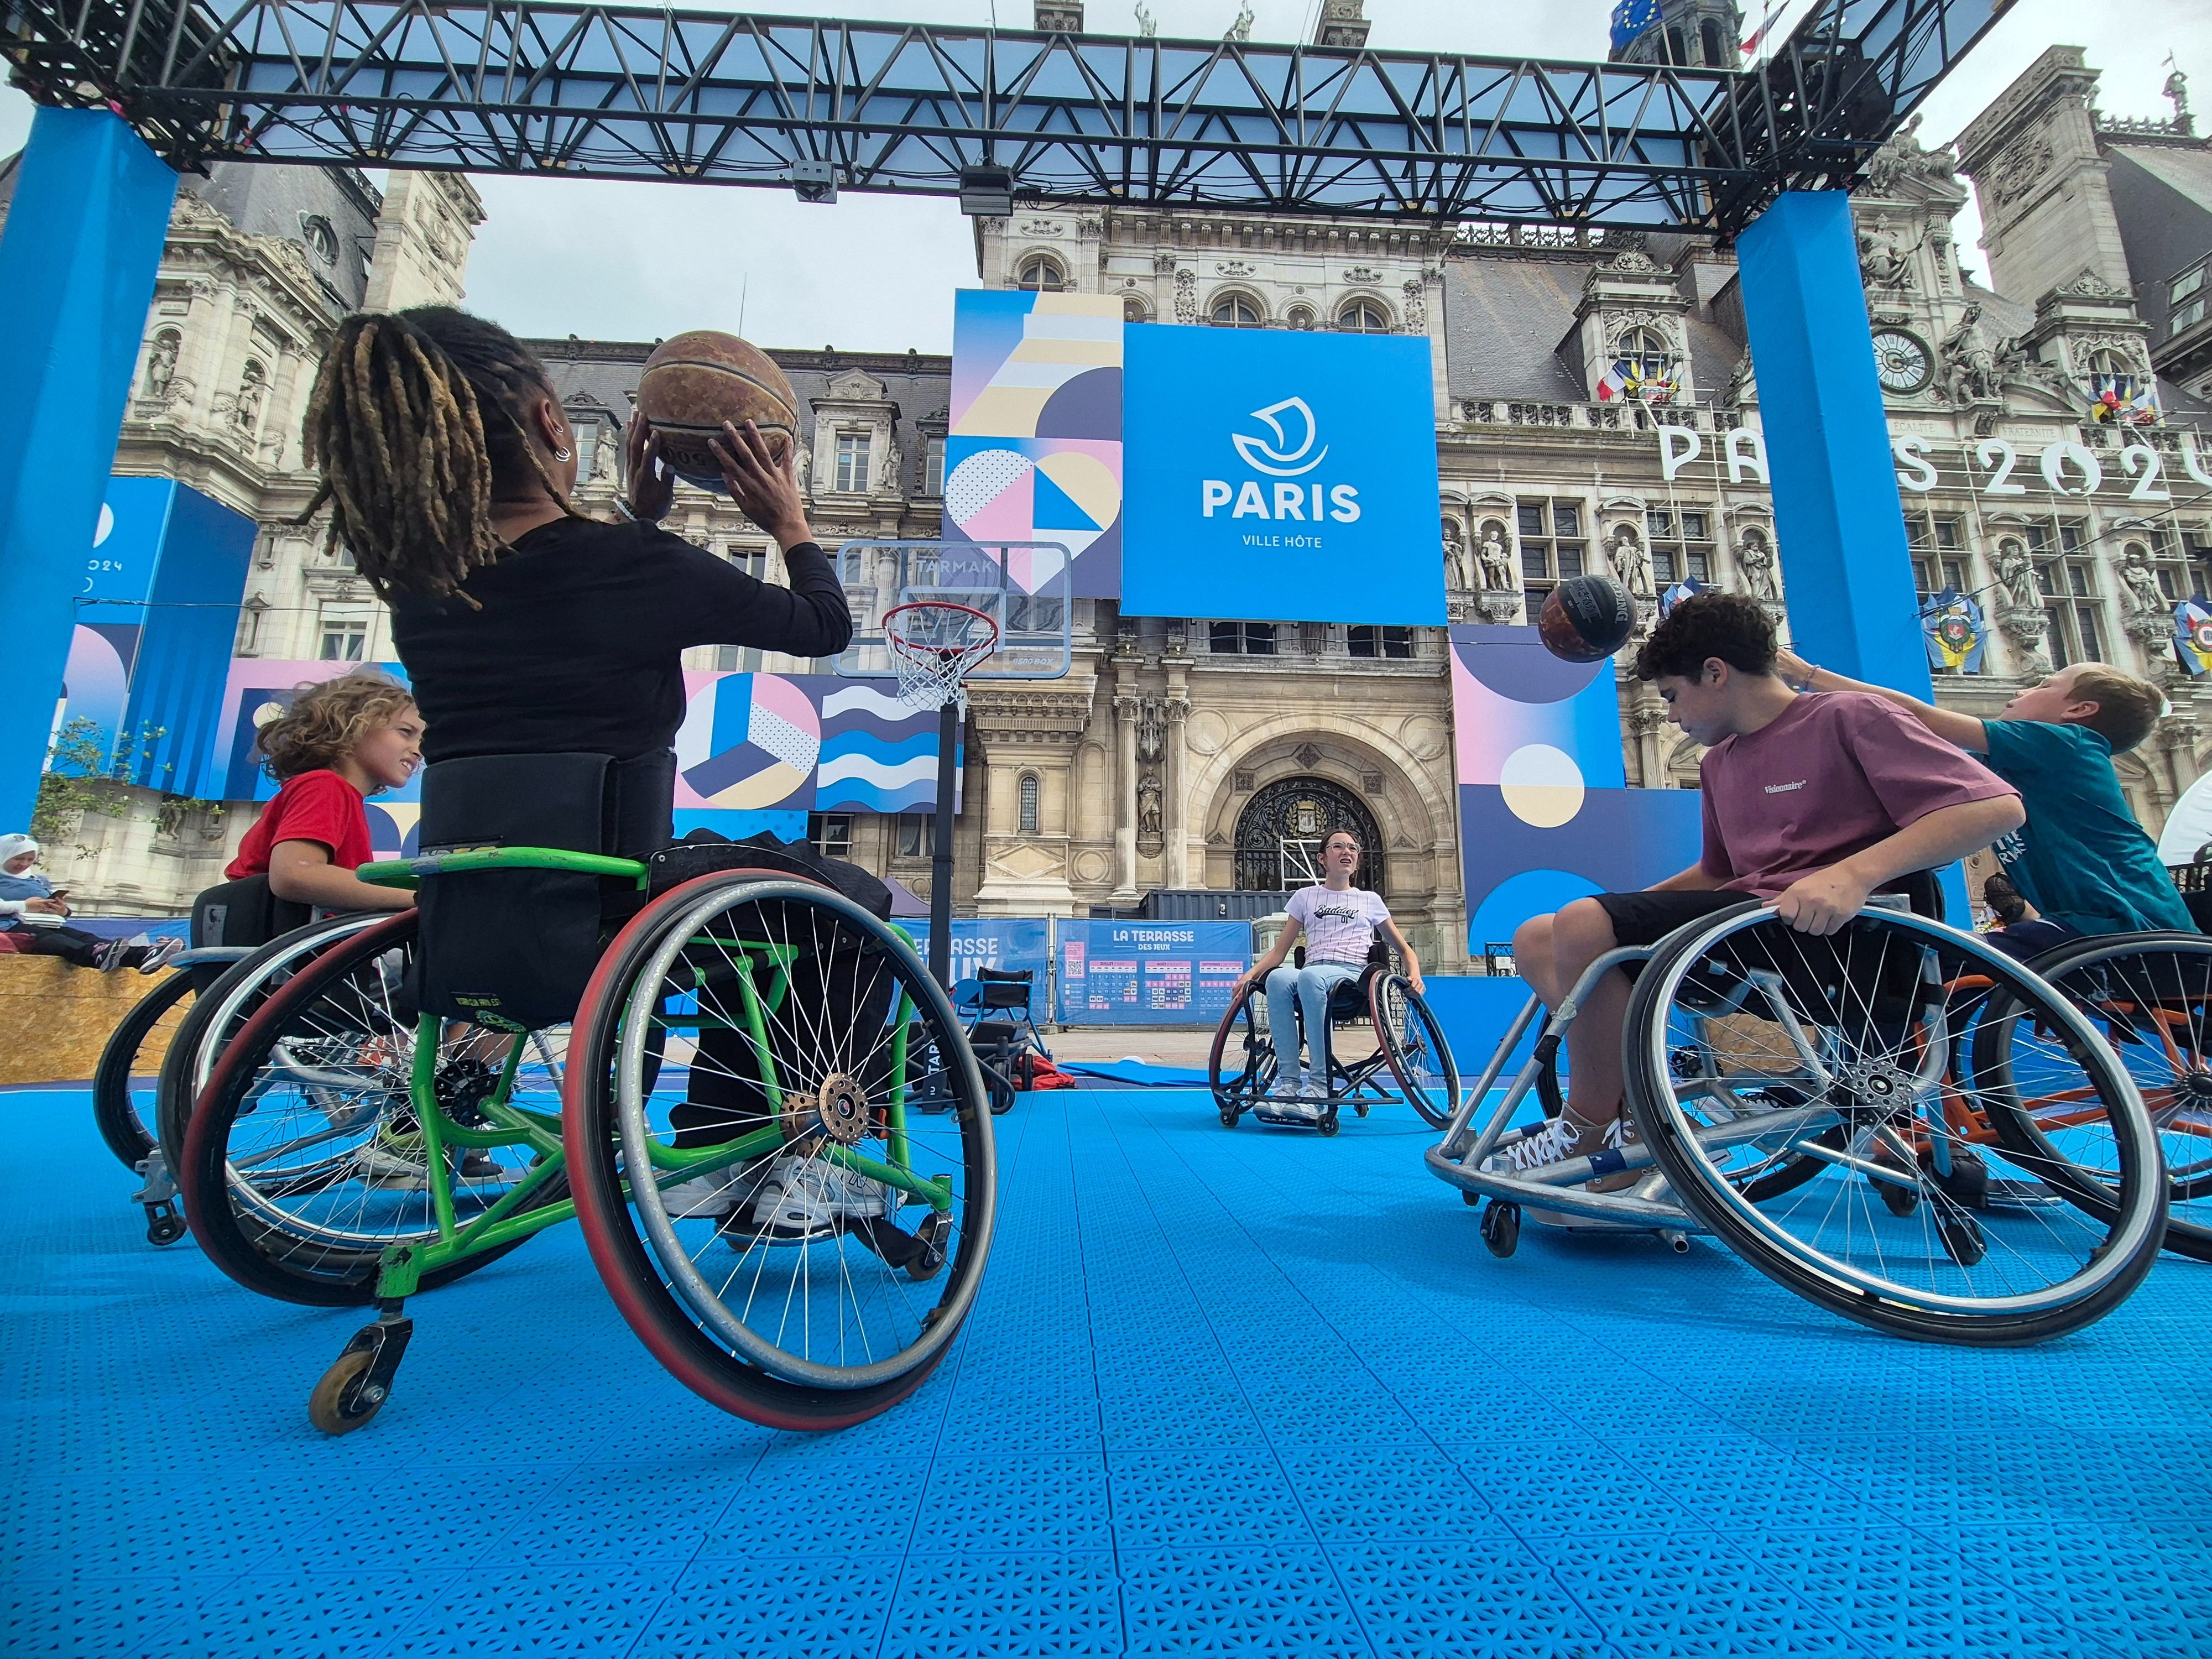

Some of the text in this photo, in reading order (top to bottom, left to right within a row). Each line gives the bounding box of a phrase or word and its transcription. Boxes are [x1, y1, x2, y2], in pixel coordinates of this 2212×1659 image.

[1658, 425, 1938, 492] PAS
[1202, 479, 1361, 523] PARIS
[1242, 534, 1322, 548] VILLE HÔTE
[87, 560, 122, 571] 024
[916, 560, 994, 573] TARMAK
[1113, 930, 1194, 942] LA TERRASSE
